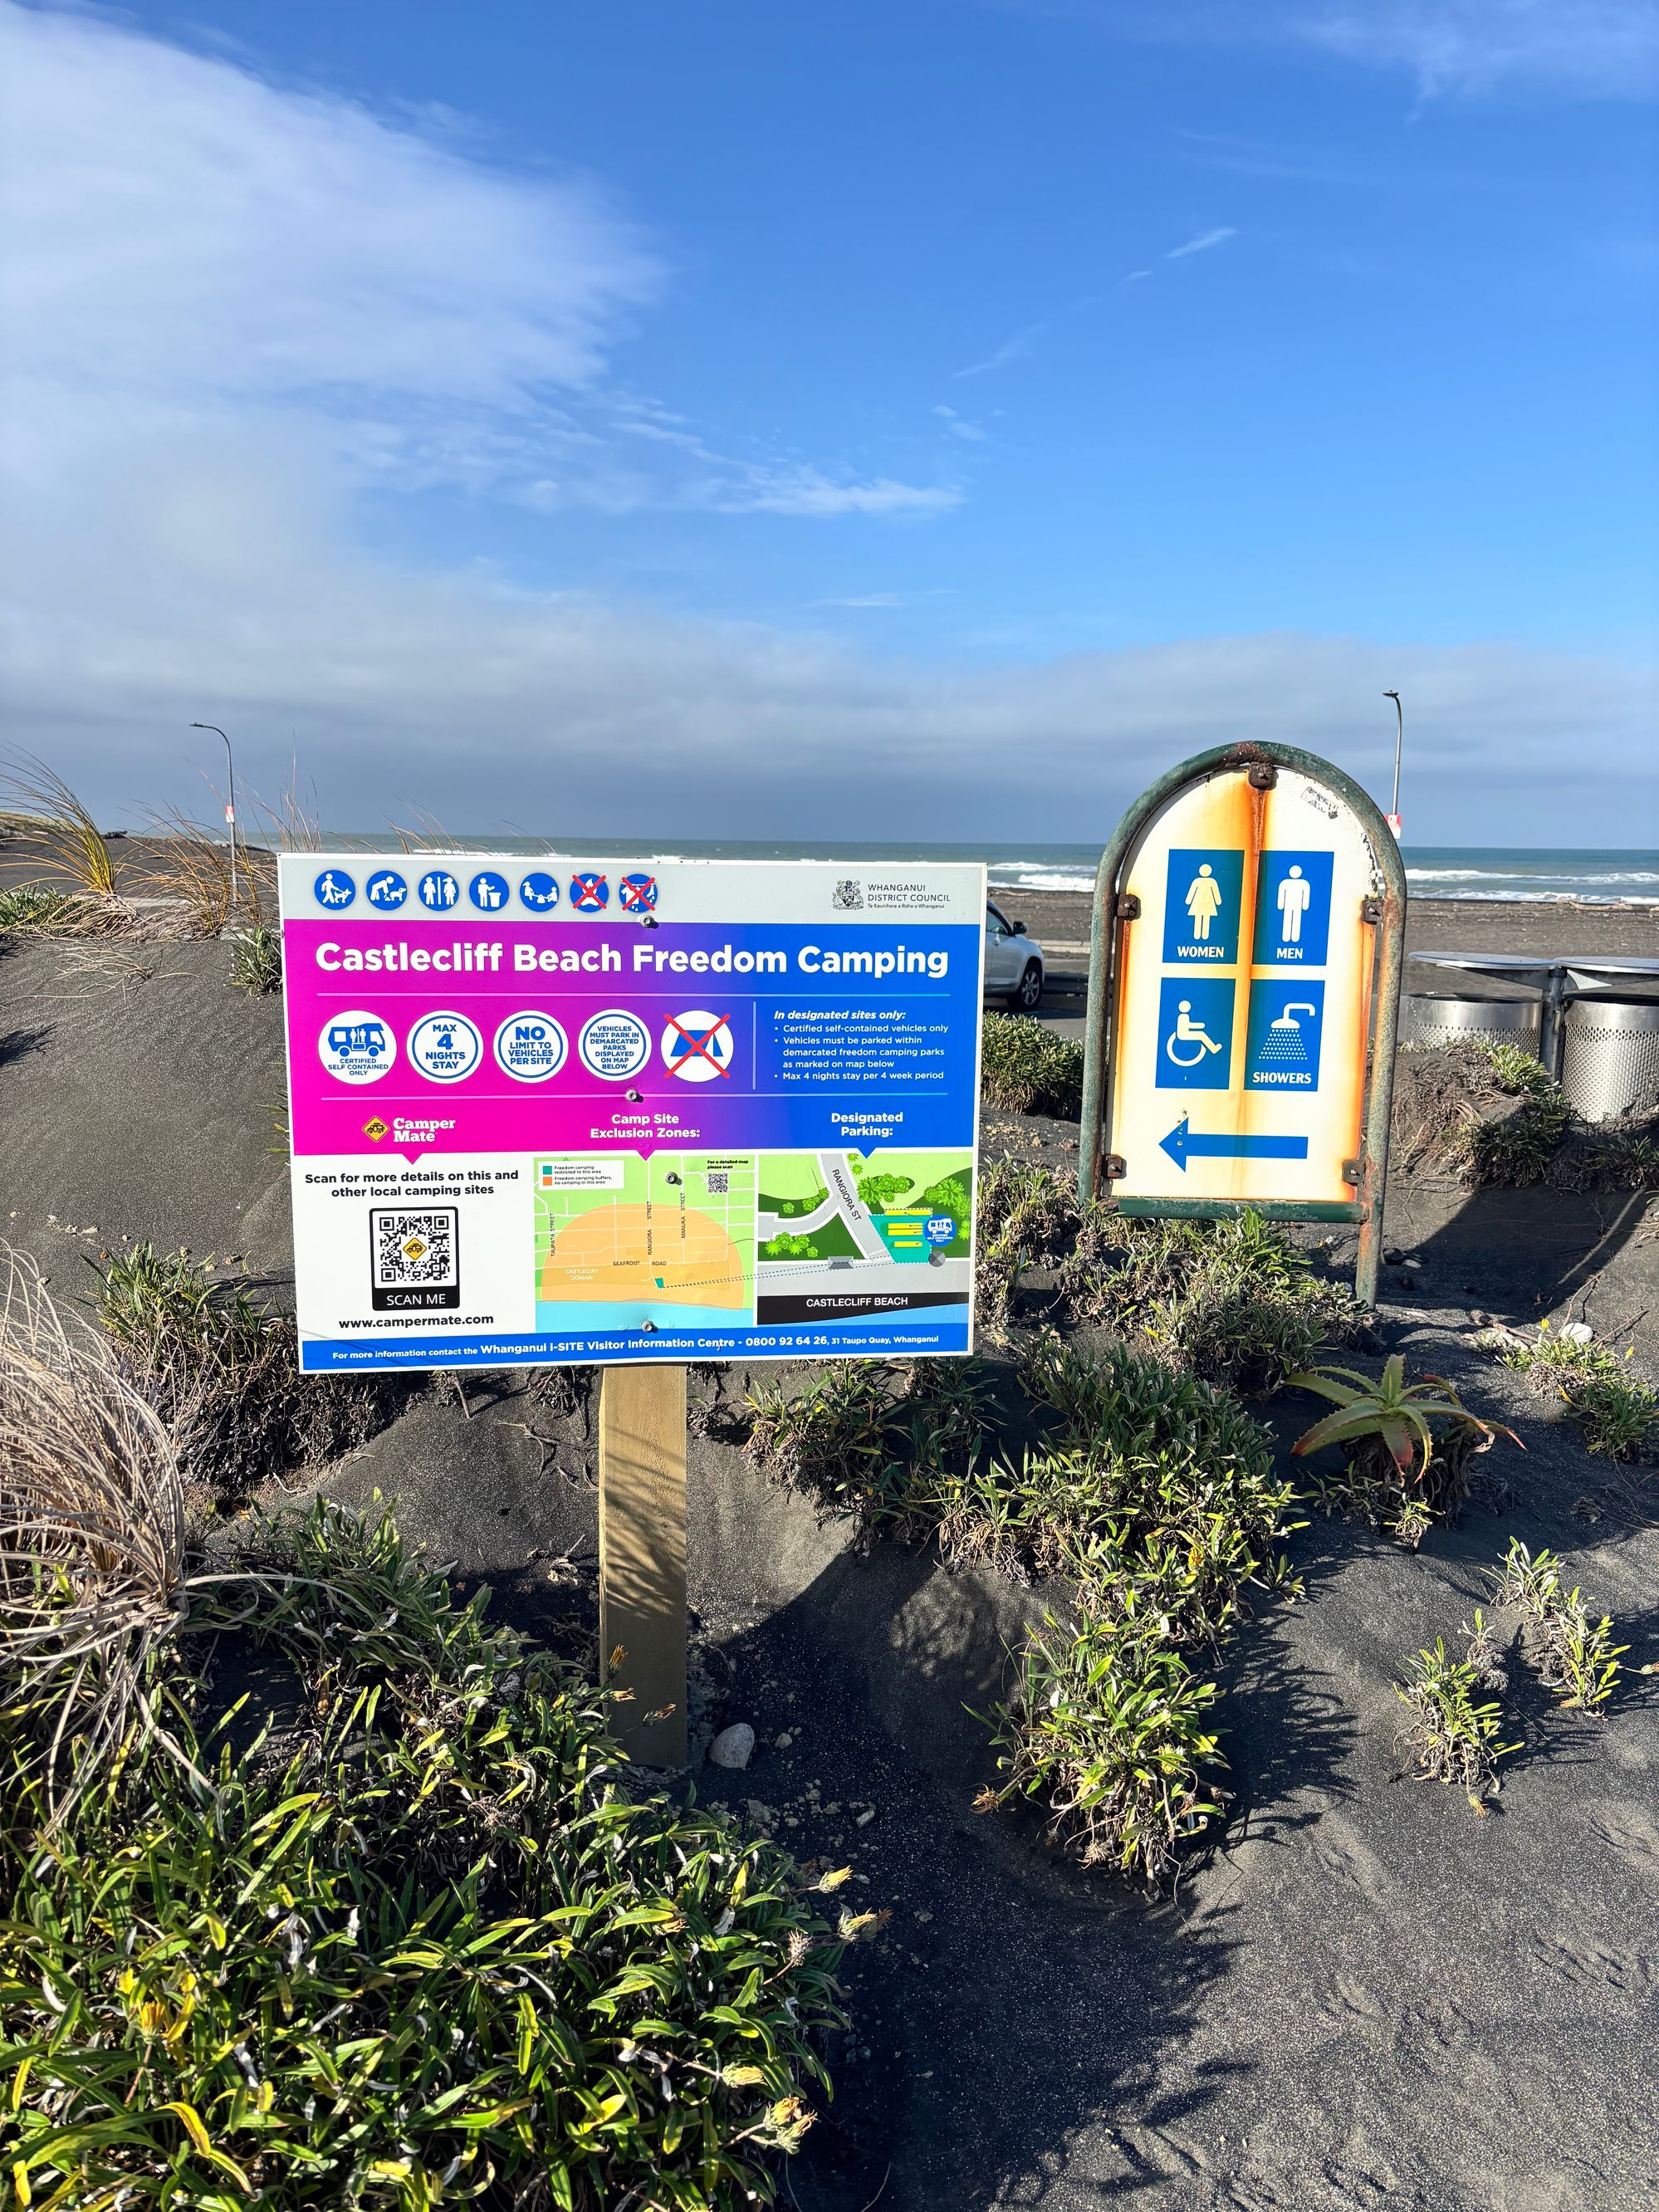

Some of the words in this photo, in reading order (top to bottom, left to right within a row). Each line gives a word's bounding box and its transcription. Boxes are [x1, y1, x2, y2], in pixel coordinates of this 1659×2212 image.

[1177, 946, 1224, 957] WOMEN
[1276, 947, 1303, 958] MEN
[316, 942, 502, 971] Castlecliff
[513, 942, 621, 971] Beach
[633, 944, 786, 972] Freedom
[798, 945, 947, 978] Camping
[774, 1011, 785, 1019] In
[787, 1010, 849, 1020] designated
[850, 1010, 876, 1019] sites
[878, 1010, 906, 1020] only:
[433, 1024, 457, 1034] MAX
[515, 1026, 546, 1040] NO
[783, 1024, 822, 1032] Certified
[825, 1024, 888, 1032] self-contained
[929, 1024, 948, 1033] only
[437, 1033, 453, 1050] 4
[861, 1036, 892, 1045] parked
[425, 1051, 465, 1060] NIGHTS
[508, 1050, 553, 1058] VEHICLES
[879, 1048, 918, 1056] camping
[920, 1048, 944, 1056] parks
[812, 1072, 839, 1080] nights
[842, 1072, 860, 1080] stay
[915, 1071, 943, 1079] period
[1252, 1072, 1311, 1084] SHOWERS
[393, 1116, 455, 1132] Camper
[611, 1113, 650, 1125] Camp
[653, 1113, 679, 1123] Site
[831, 1112, 903, 1124] Designated
[394, 1130, 435, 1142] Mate
[590, 1128, 653, 1138] Exclusion
[657, 1128, 700, 1138] Zones:
[841, 1125, 893, 1137] Parking:
[305, 1173, 336, 1183] Scan
[340, 1172, 360, 1182] for
[400, 1171, 444, 1182] details
[467, 1170, 491, 1180] this
[494, 1170, 518, 1179] and
[331, 1187, 366, 1197] other
[370, 1186, 401, 1196] local
[404, 1185, 460, 1197] camping
[464, 1185, 494, 1194] sites
[832, 1168, 855, 1211] RANGIORA
[851, 1210, 862, 1221] ST
[386, 1294, 421, 1305] SCAN
[426, 1294, 445, 1304] ME
[806, 1297, 871, 1307] CASTLECLIFF
[874, 1297, 908, 1305] BEACH
[338, 1314, 493, 1330] www.campermate.com
[374, 1348, 426, 1358] information
[480, 1343, 546, 1355] Whanganui
[587, 1341, 624, 1350] Visitor
[628, 1339, 694, 1348] Information
[697, 1338, 735, 1348] Centre
[745, 1337, 776, 1346] 0800
[779, 1337, 792, 1345] 92
[795, 1336, 810, 1345] 64
[813, 1336, 830, 1345] 26,
[842, 1337, 866, 1345] Taupo
[869, 1336, 891, 1344] Quay,
[893, 1335, 938, 1343] Whanganui
